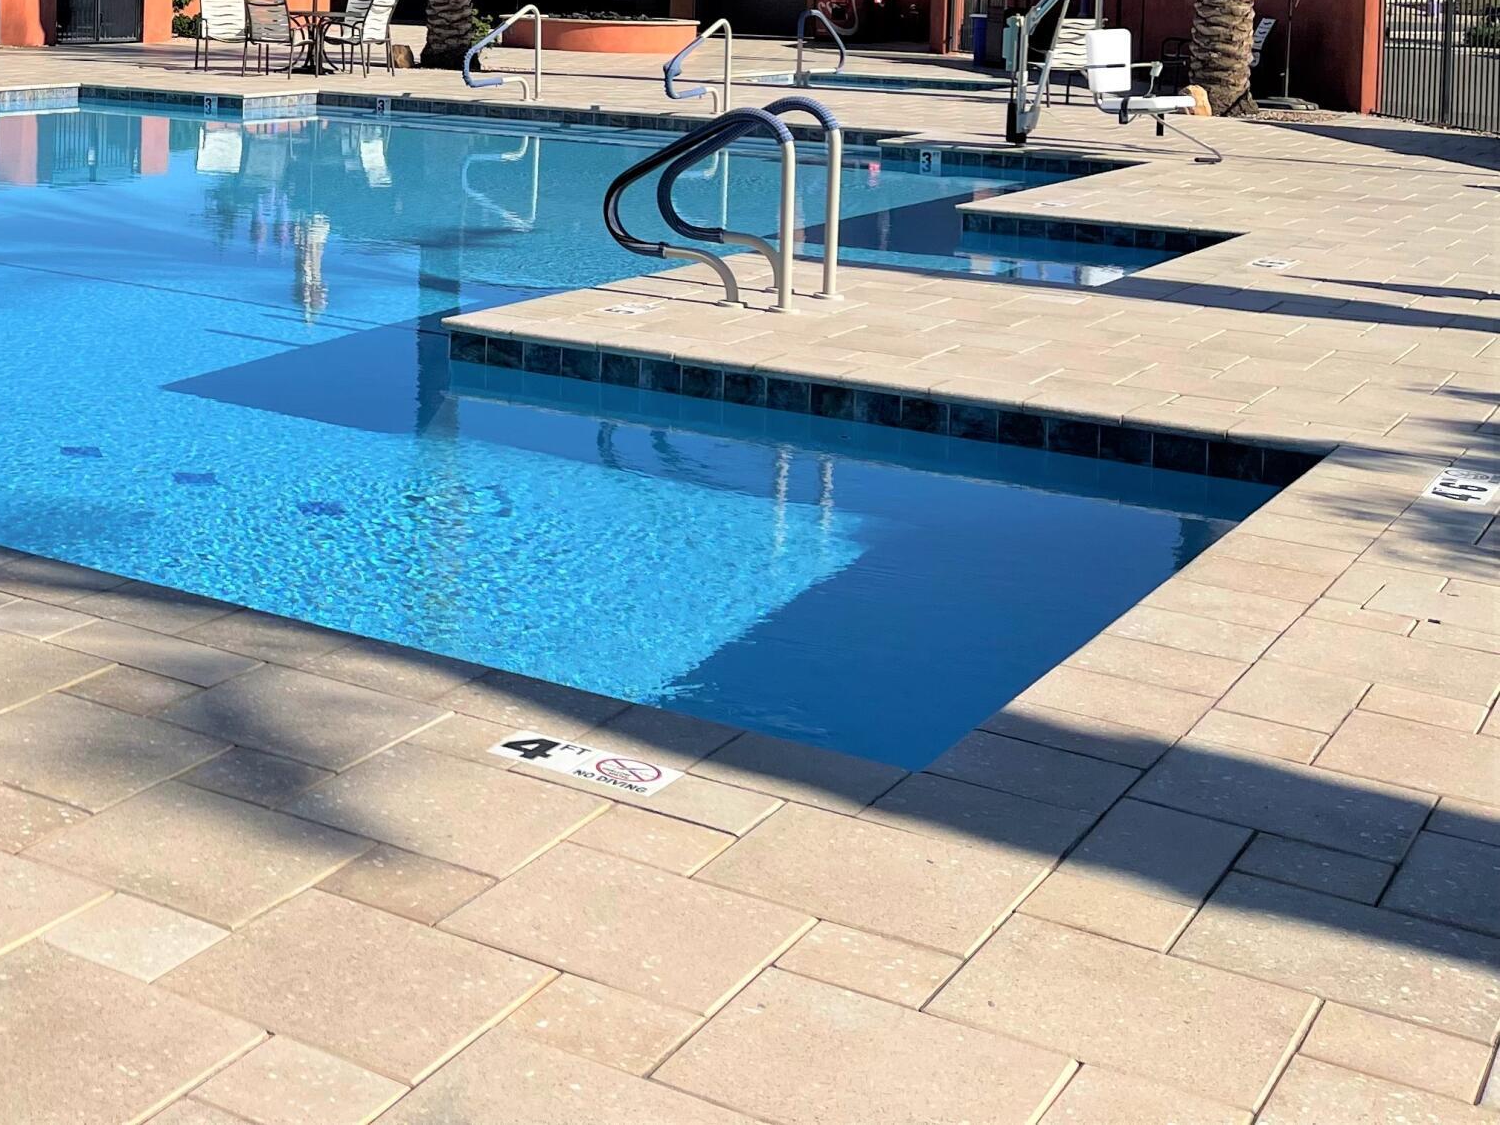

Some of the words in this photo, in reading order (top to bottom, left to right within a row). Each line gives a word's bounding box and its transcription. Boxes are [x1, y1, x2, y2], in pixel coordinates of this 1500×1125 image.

[501, 738, 561, 760] 4
[560, 744, 592, 755] FT
[573, 769, 596, 779] NO
[596, 775, 648, 793] DIVING
